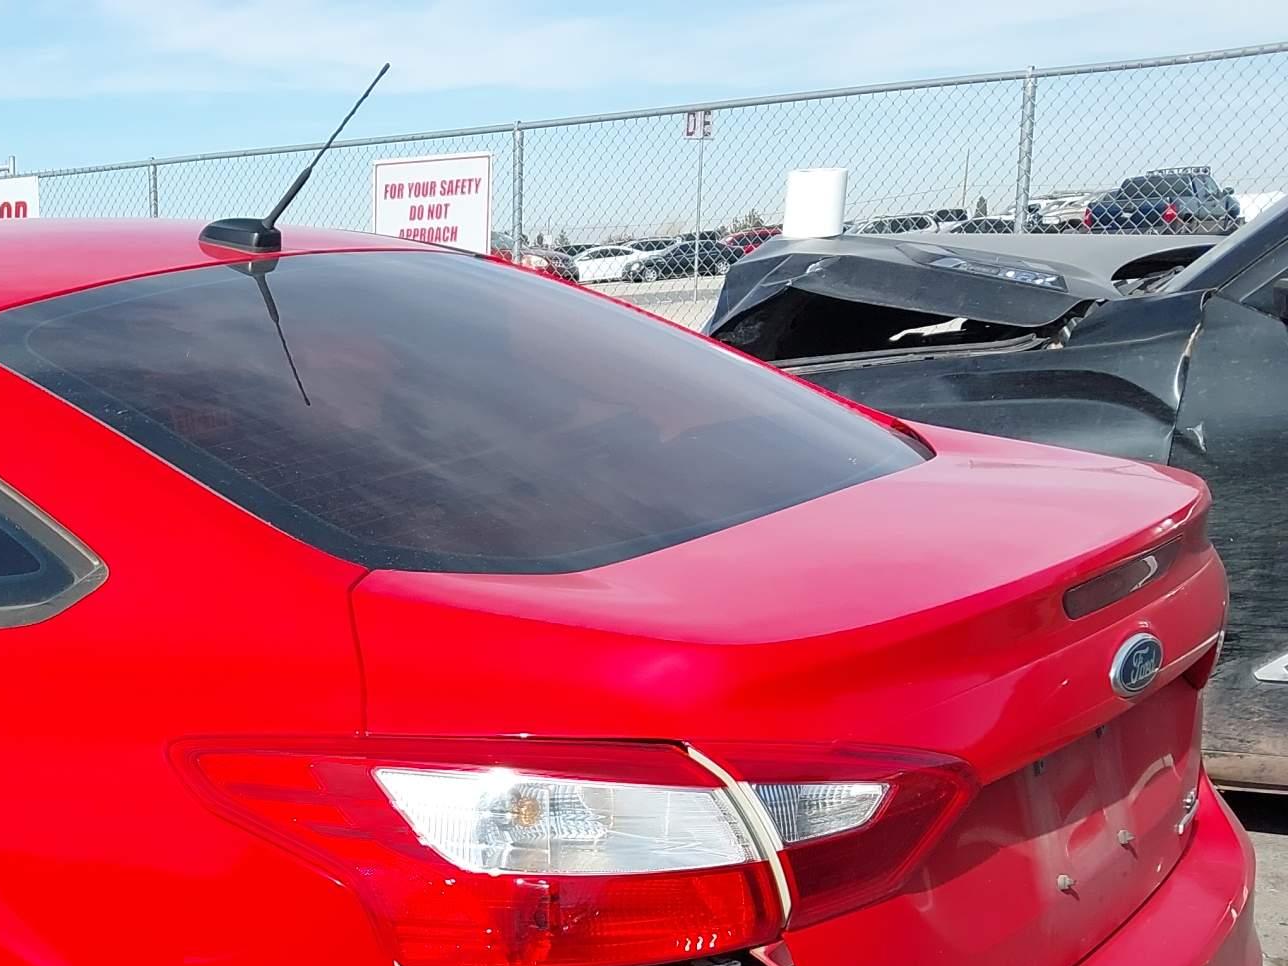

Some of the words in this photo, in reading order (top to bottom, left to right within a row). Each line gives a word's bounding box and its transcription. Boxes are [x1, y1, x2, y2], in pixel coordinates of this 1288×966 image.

[383, 183, 405, 200] FOR
[407, 181, 437, 199] YOUR
[440, 178, 482, 197] SAFETY
[408, 204, 425, 221] DO
[427, 203, 451, 221] NOT
[1125, 645, 1157, 687] Ford
